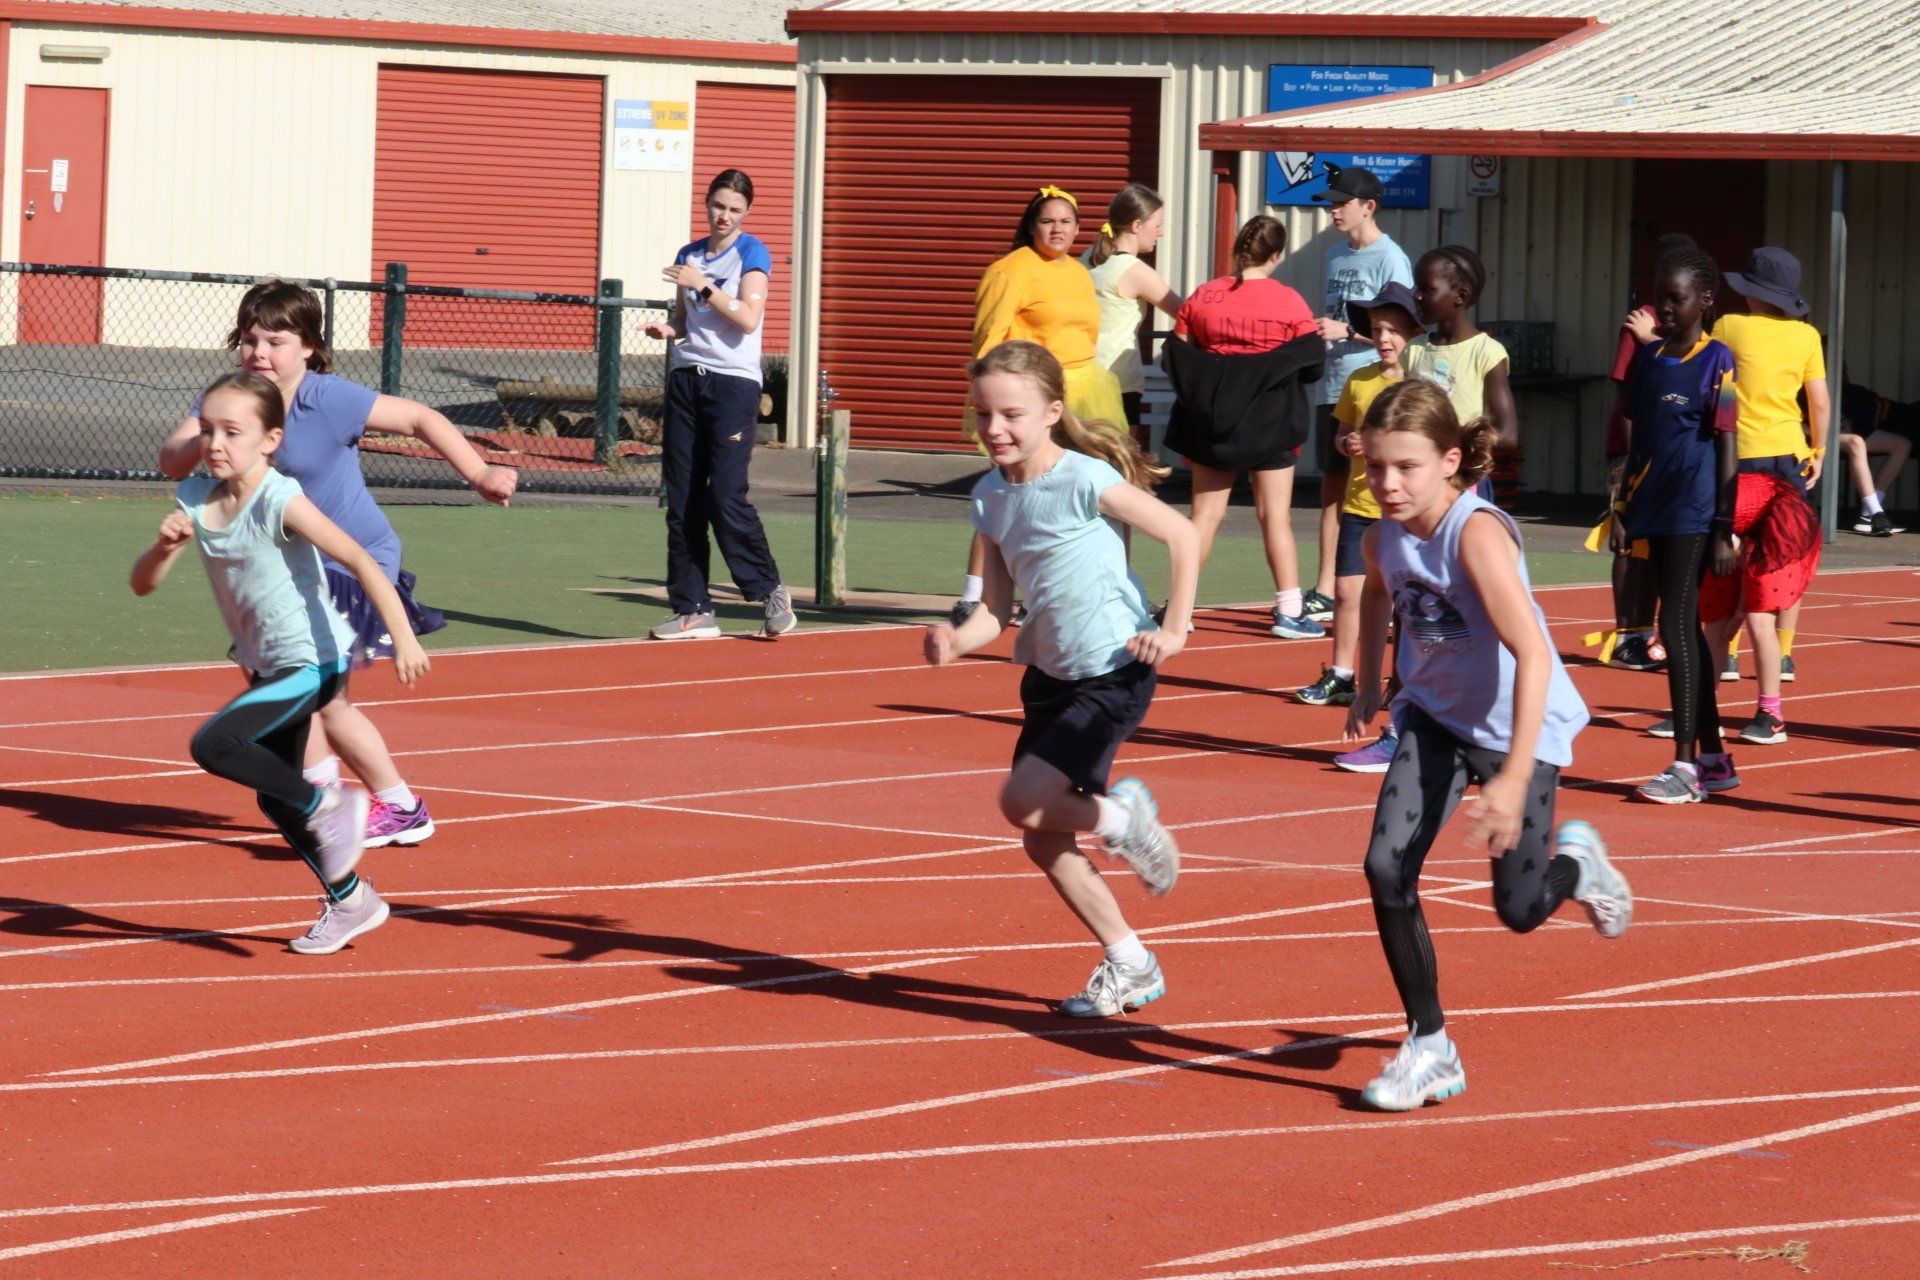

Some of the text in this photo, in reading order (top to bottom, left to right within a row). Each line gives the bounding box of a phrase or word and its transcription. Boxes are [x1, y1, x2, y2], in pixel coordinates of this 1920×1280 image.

[655, 110, 666, 120] UV
[1202, 289, 1225, 304] GO
[1203, 317, 1295, 350] UNITY
